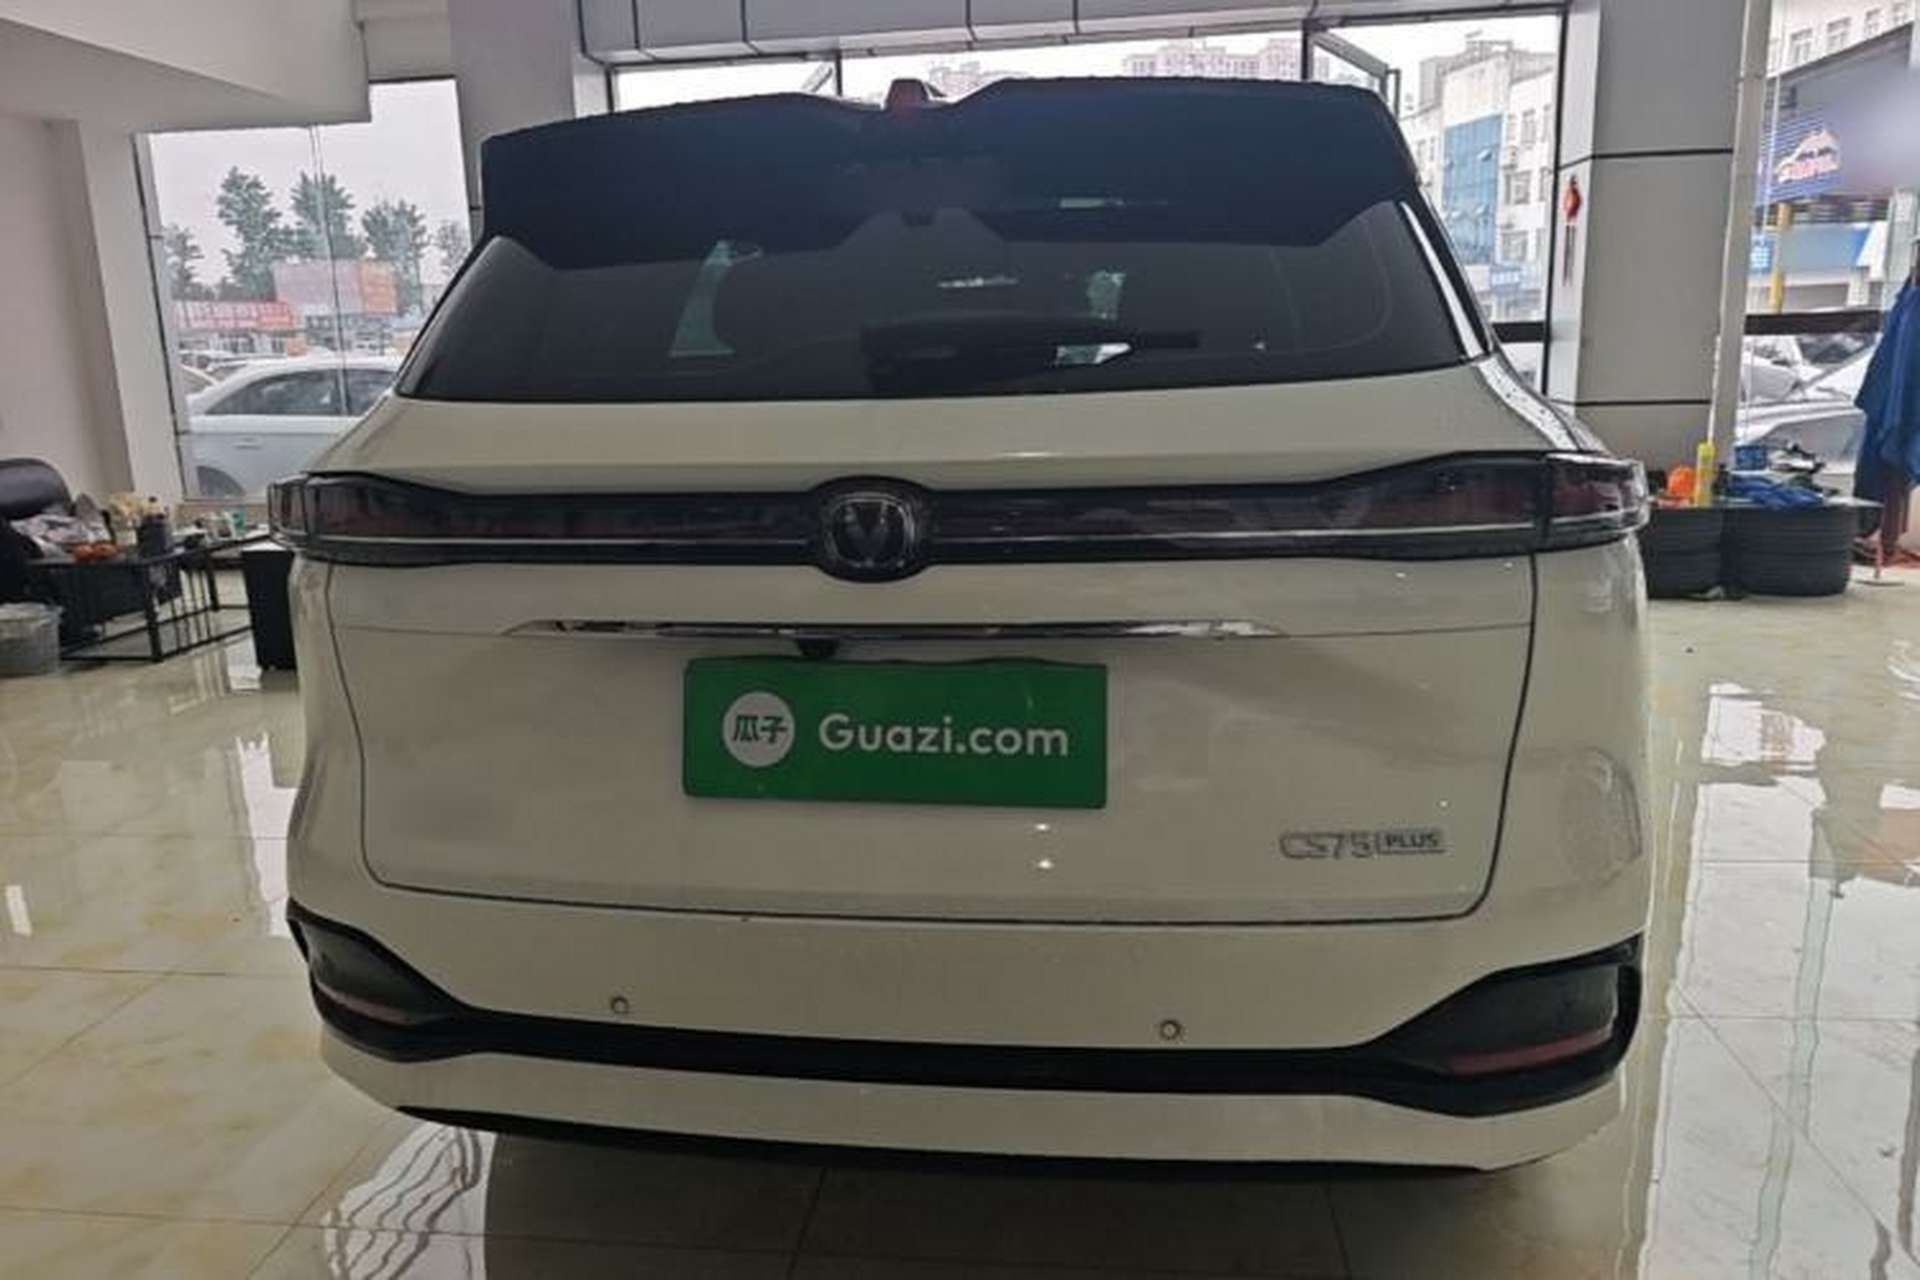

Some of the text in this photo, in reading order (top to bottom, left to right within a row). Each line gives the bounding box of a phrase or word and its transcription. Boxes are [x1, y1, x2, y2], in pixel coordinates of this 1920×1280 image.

[731, 714, 788, 744] 瓜子
[819, 713, 1069, 757] Guazi.com
[1279, 831, 1441, 859] CS75 PLUS
